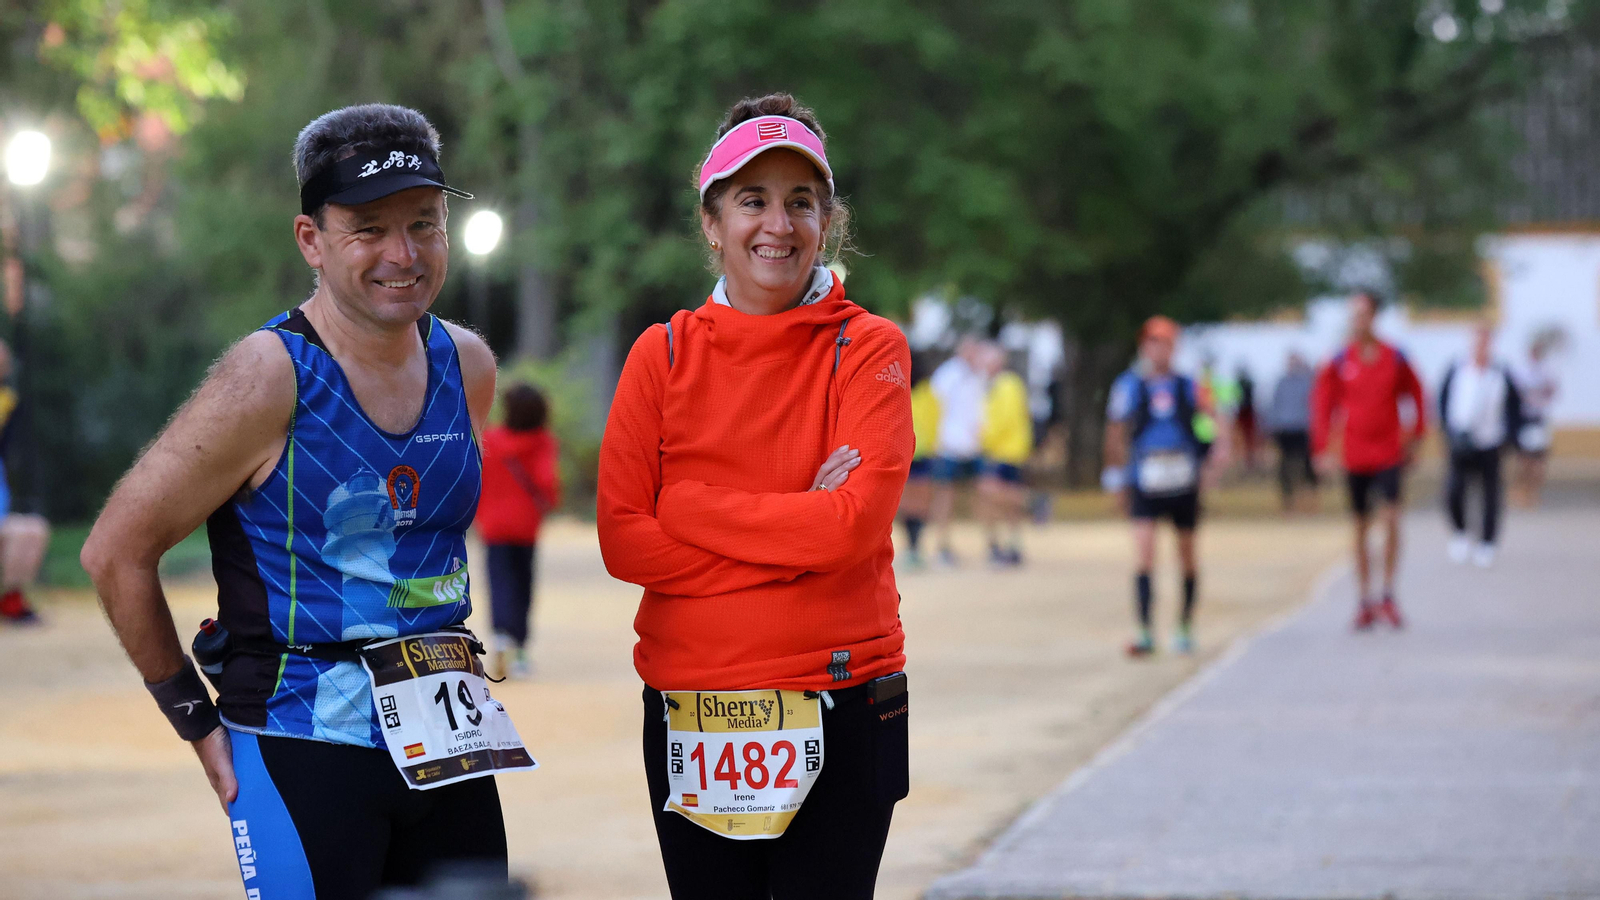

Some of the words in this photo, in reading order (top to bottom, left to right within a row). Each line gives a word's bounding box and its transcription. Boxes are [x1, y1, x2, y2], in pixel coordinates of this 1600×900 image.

[409, 639, 467, 666] Sherry
[434, 679, 483, 732] 19
[703, 695, 774, 725] Sherry
[879, 704, 908, 721] WONG
[727, 718, 763, 729] Media
[454, 729, 483, 742] ISIDRO
[447, 743, 474, 756] BAEZA
[691, 740, 799, 791] 1482
[734, 793, 756, 801] Irene
[713, 804, 746, 813] Pacheco
[232, 820, 257, 881] PEÑA
